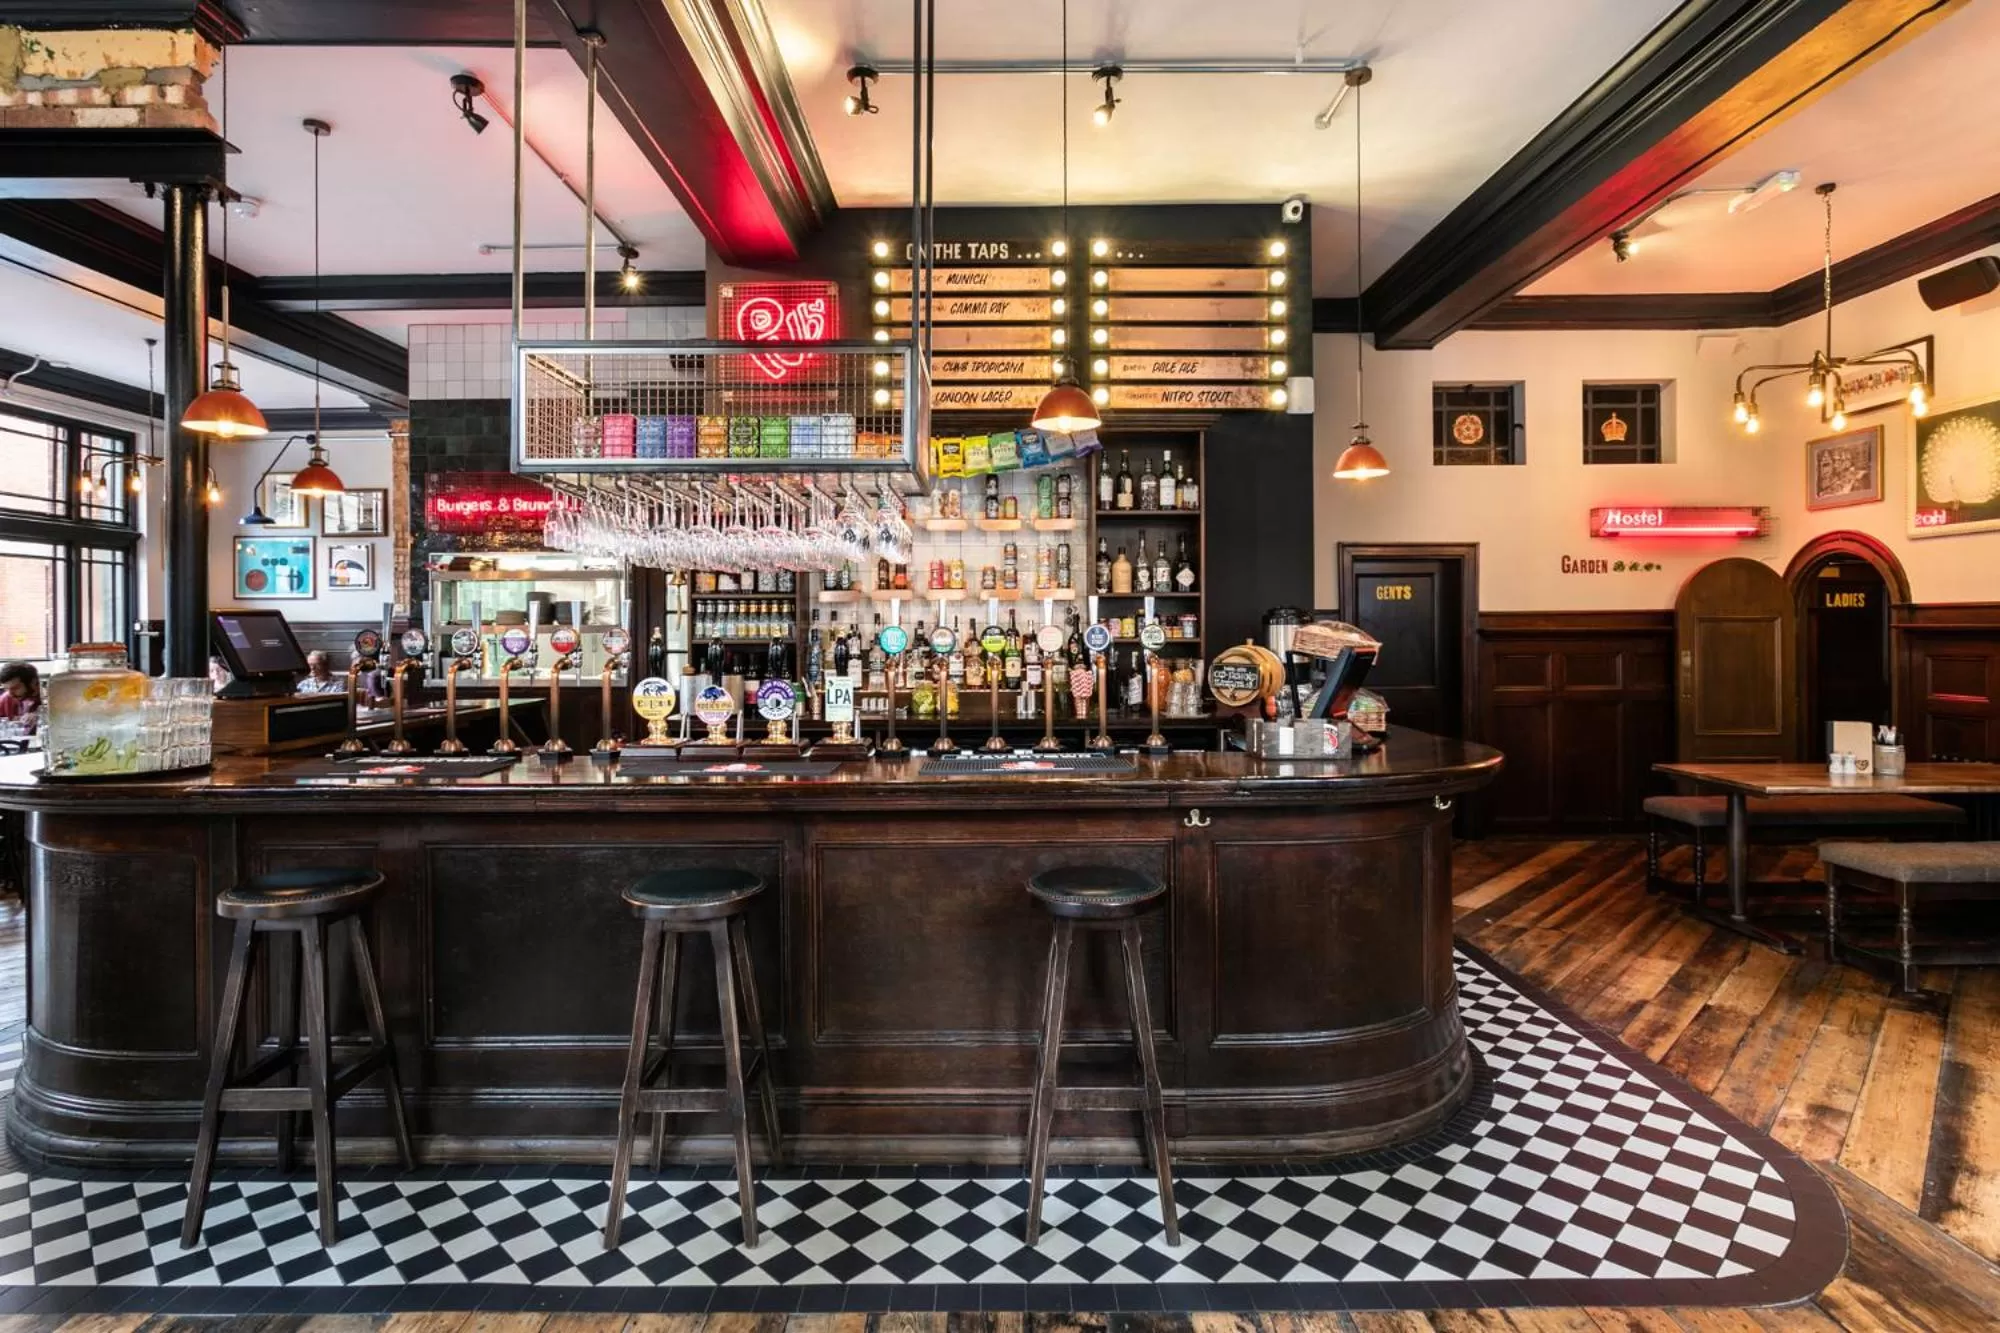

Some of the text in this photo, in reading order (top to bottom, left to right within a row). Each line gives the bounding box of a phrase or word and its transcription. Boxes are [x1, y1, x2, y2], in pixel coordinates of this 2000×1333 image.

[933, 244, 961, 259] THE
[968, 243, 1009, 259] TAPS
[946, 273, 989, 285] MUNICH
[989, 302, 1010, 314] RAY
[971, 361, 1024, 374] TROPICANA
[1152, 362, 1176, 373] PALE
[1178, 361, 1200, 373] ALE
[935, 391, 979, 403] LONDON
[1161, 391, 1194, 403] NITRO
[1198, 391, 1233, 403] STOUT
[436, 498, 493, 515] Burgers
[498, 497, 510, 512] &
[1606, 508, 1663, 526] Hostel
[1561, 555, 1608, 574] GARDEN
[1376, 585, 1412, 600] GENTS
[1826, 592, 1866, 608] LADIES
[827, 688, 852, 705] LPA
